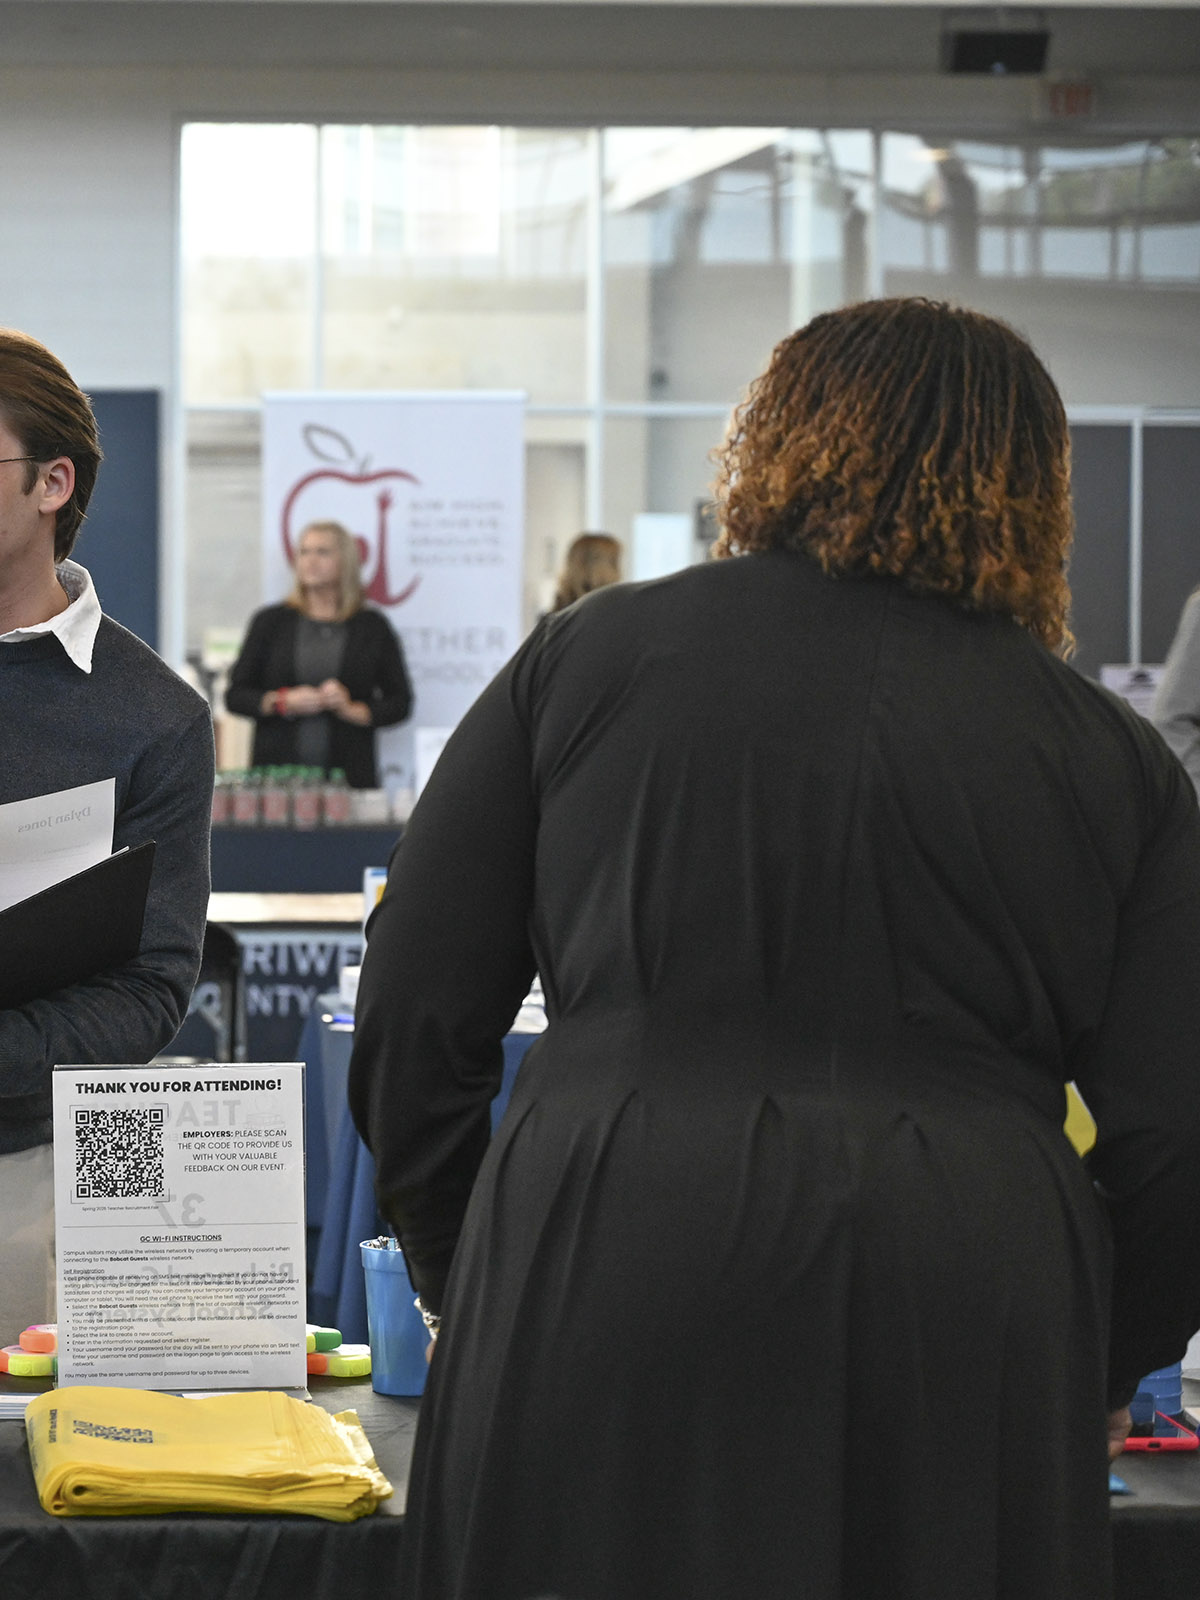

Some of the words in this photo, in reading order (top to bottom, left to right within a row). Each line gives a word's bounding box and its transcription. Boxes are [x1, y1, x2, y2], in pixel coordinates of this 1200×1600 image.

[75, 1083, 127, 1094] THANK
[130, 1082, 160, 1093] YOU
[163, 1081, 191, 1092] FOR
[193, 1079, 282, 1092] ATTENDING!
[183, 1131, 234, 1139] EMPLOYERS:
[235, 1130, 262, 1138] PLEASE
[264, 1129, 287, 1137] SCAN
[178, 1142, 192, 1150] THE
[194, 1142, 206, 1150] QR
[207, 1141, 231, 1149] CODE
[233, 1141, 244, 1149] TO
[281, 1140, 293, 1148] US
[193, 1153, 213, 1161] WITH
[238, 1152, 278, 1160] VALUABLE
[184, 1164, 225, 1172] FEEDBACK
[227, 1164, 240, 1172] ON
[260, 1163, 287, 1171] EVENT.
